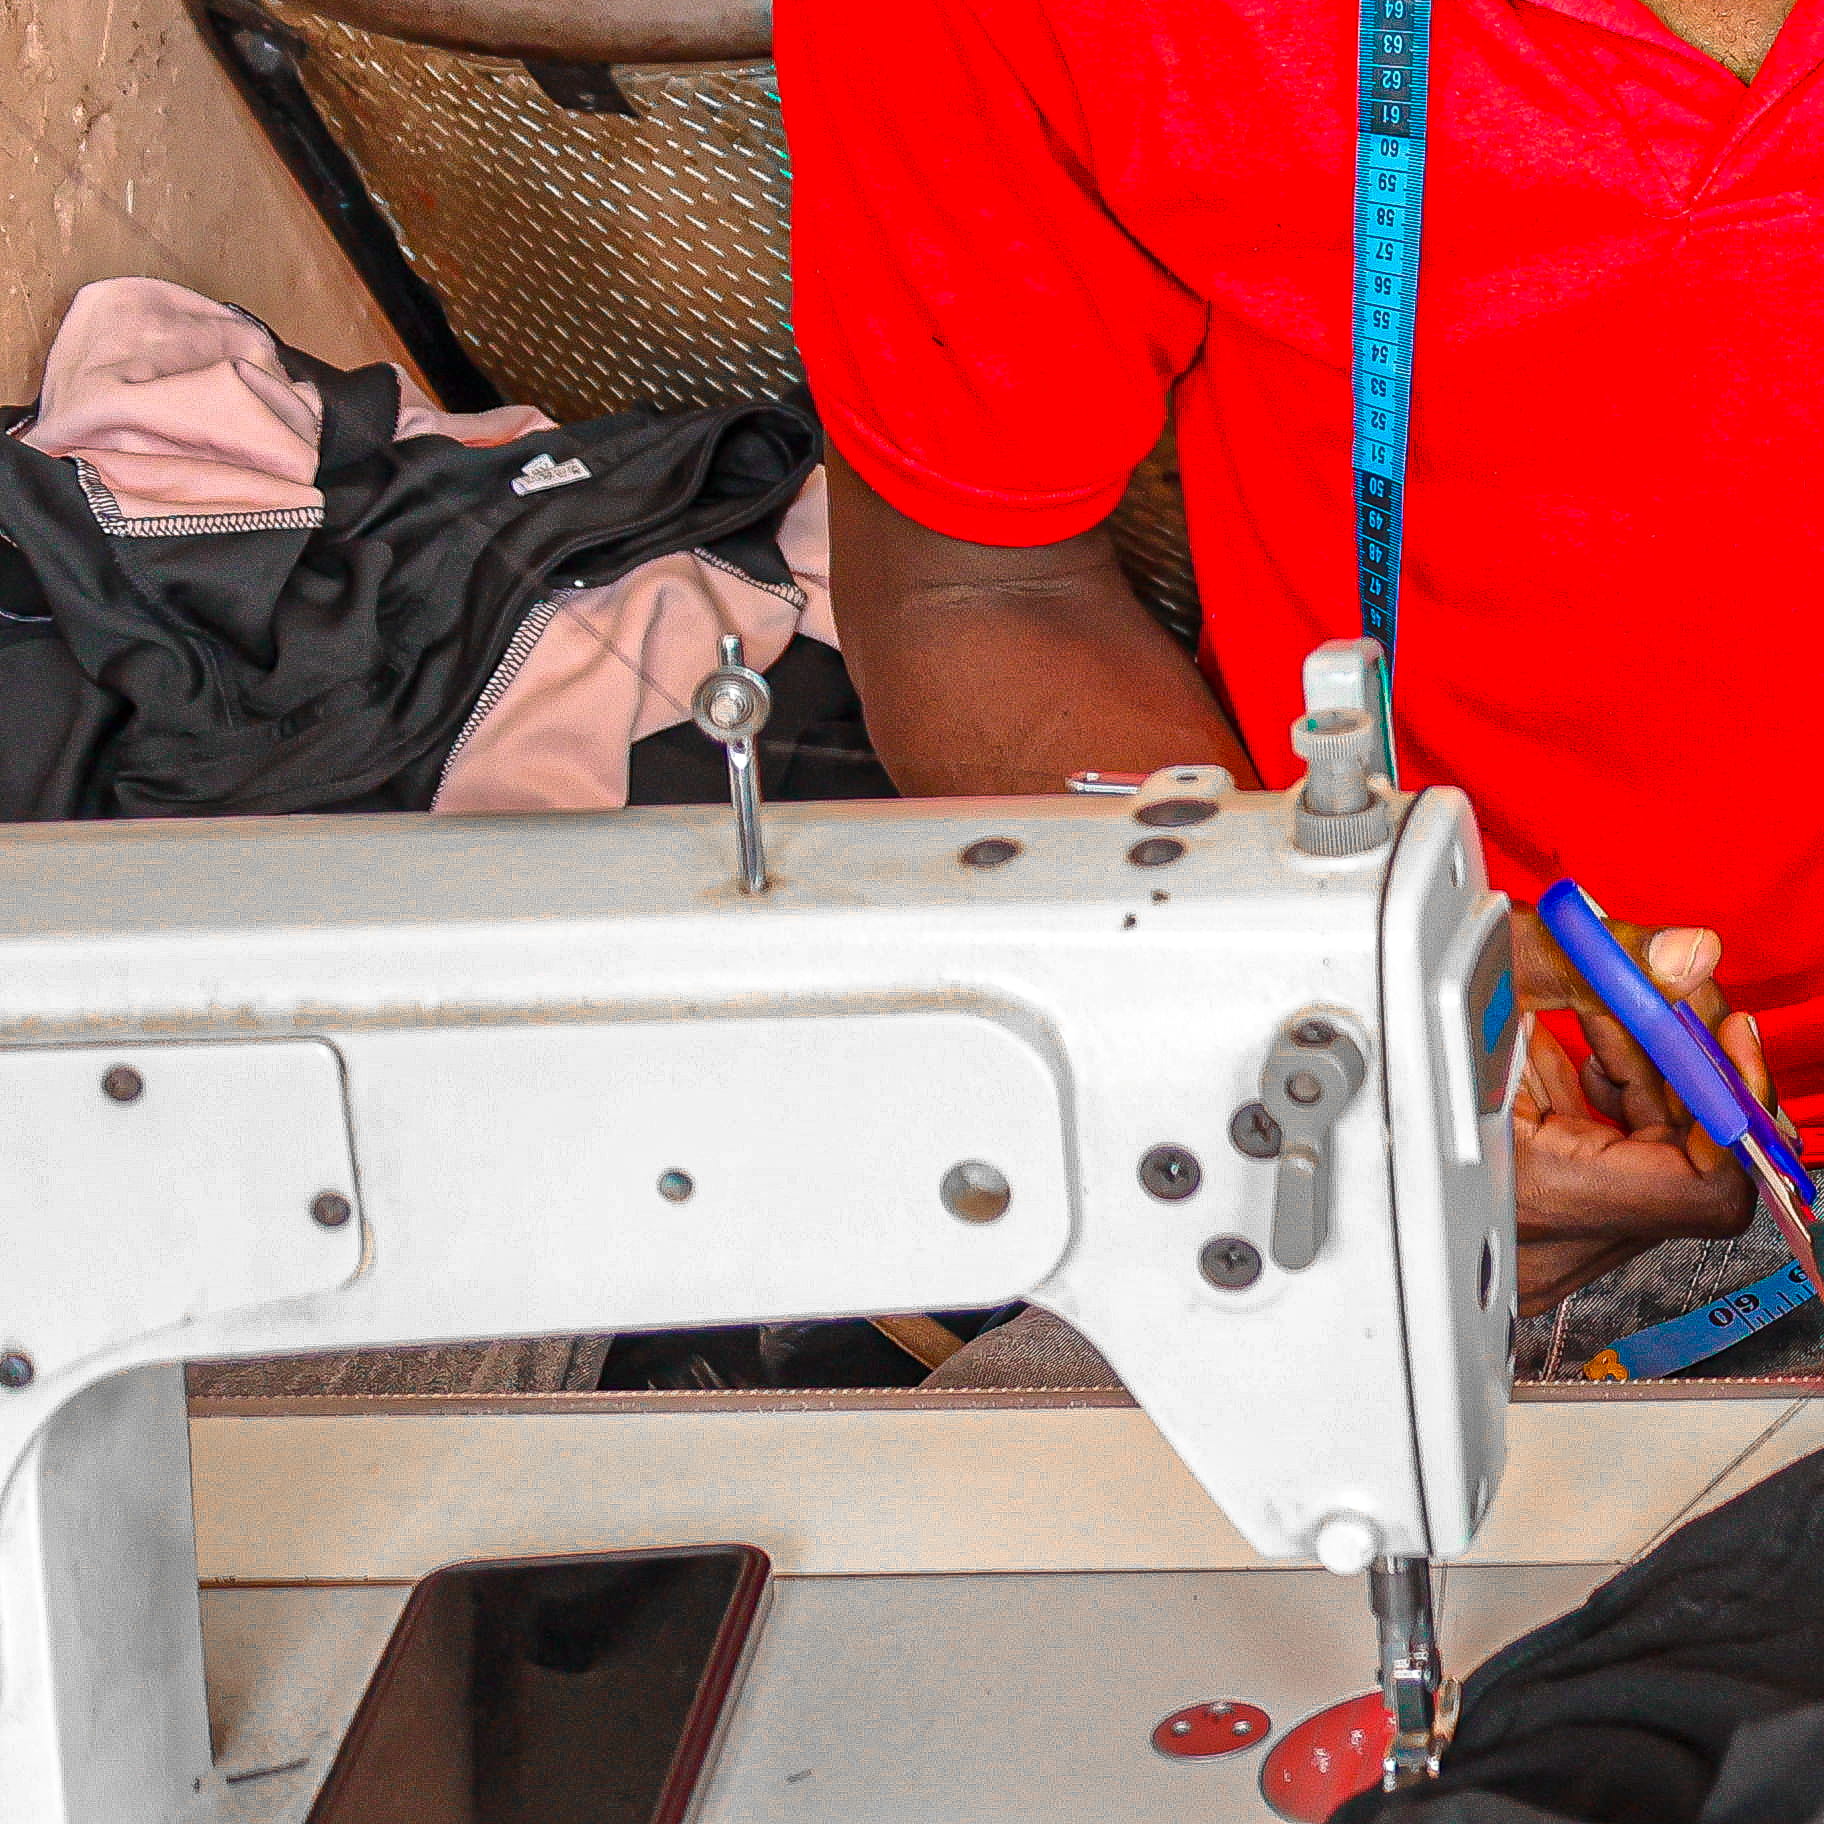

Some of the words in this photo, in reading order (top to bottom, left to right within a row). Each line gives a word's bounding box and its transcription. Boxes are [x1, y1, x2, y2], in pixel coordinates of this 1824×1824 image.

[1385, 0, 1403, 18] 64
[1384, 36, 1402, 54] 63
[1382, 71, 1401, 89] 62
[1382, 106, 1400, 123] 61
[1381, 139, 1399, 157] 60
[1378, 174, 1396, 192] 59
[1377, 209, 1395, 226] 58
[1376, 243, 1394, 261] 57
[1374, 278, 1392, 295] 56
[1372, 311, 1390, 329] 55
[1372, 344, 1388, 363] 54
[1370, 378, 1388, 397] 53
[1370, 412, 1387, 430] 52
[1371, 445, 1386, 463] 51
[1369, 479, 1384, 498] 50
[1369, 512, 1384, 530] 49
[1369, 544, 1383, 564] 48
[1369, 578, 1381, 596] 47
